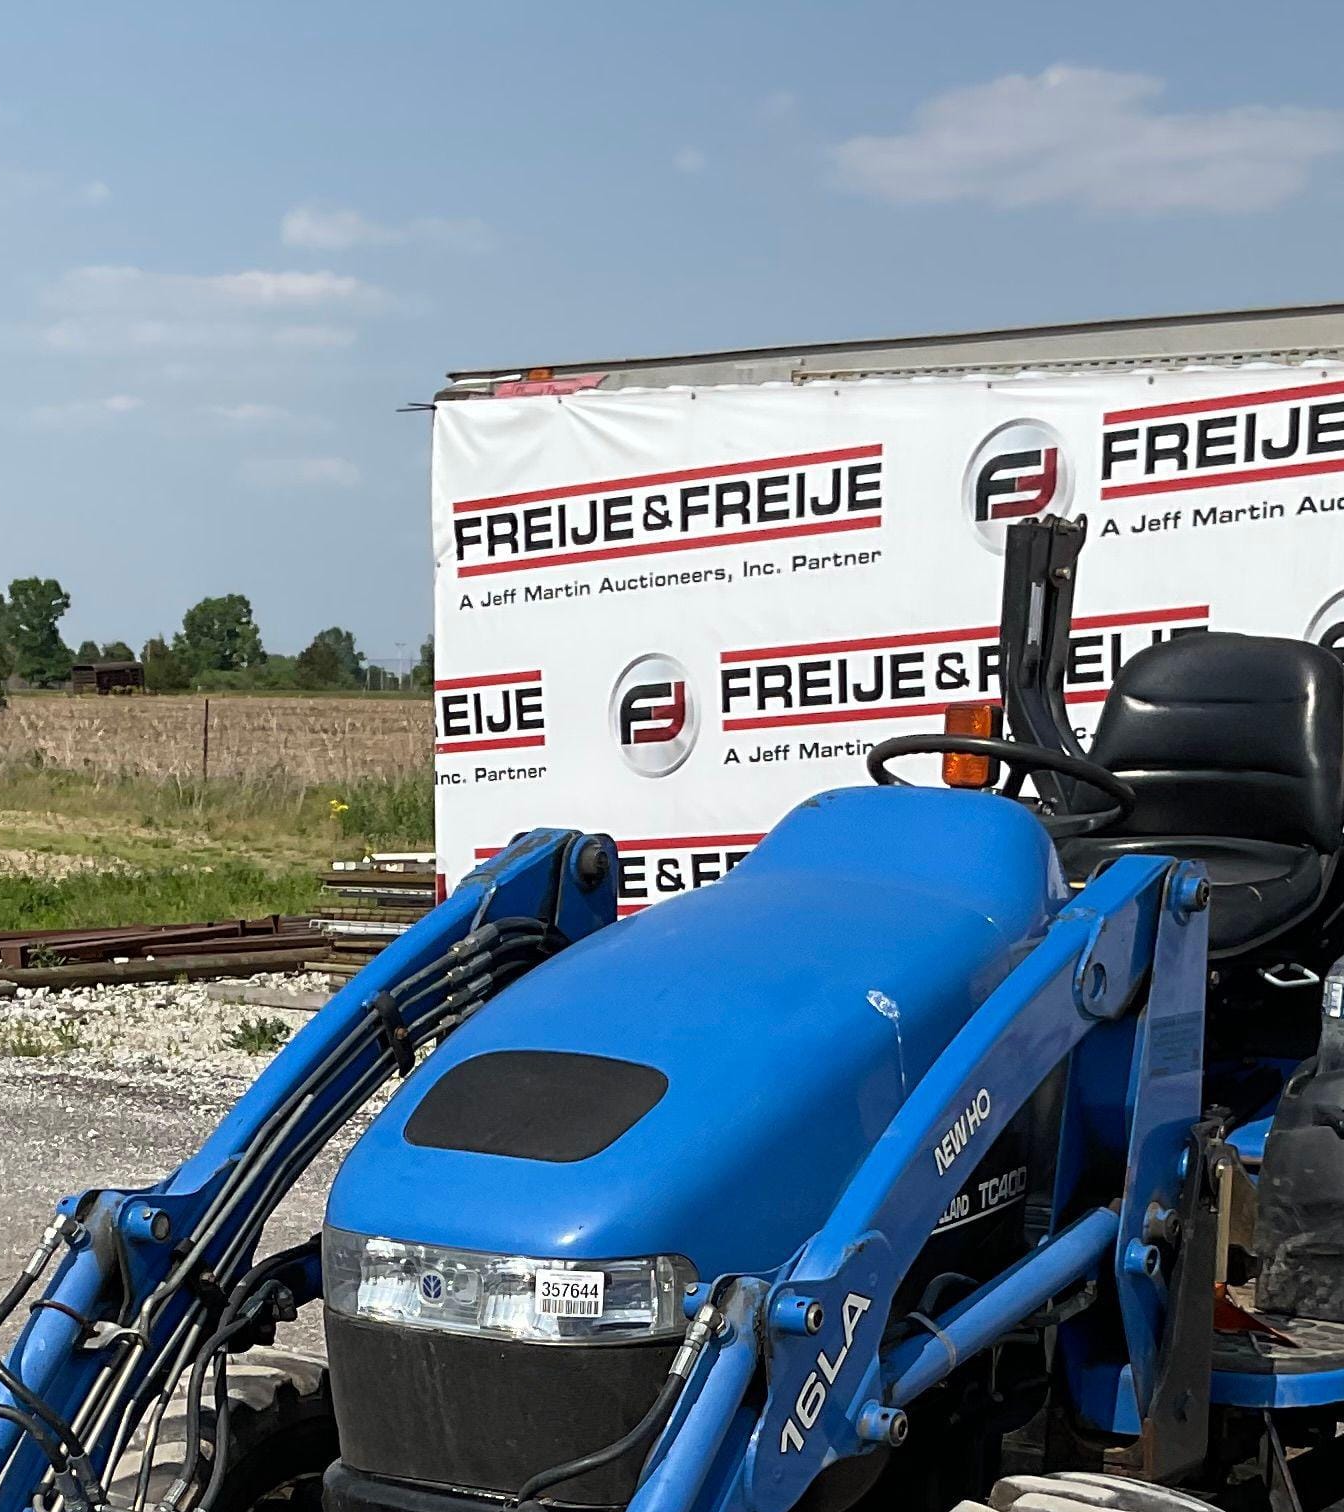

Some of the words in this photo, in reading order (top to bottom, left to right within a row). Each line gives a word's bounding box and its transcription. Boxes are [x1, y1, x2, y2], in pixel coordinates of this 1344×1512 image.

[454, 495, 634, 561] FREIJE
[642, 494, 673, 532] &
[680, 462, 883, 532] FREIJE
[1099, 519, 1121, 537] A
[1131, 511, 1182, 534] Jeff
[1192, 501, 1285, 527] Martin
[459, 594, 474, 611] A
[480, 588, 517, 608] Jeff
[524, 580, 591, 603] Martin
[599, 567, 733, 594] Auctioneers,
[743, 561, 781, 577] Inc.
[792, 550, 882, 572] Partner
[721, 651, 926, 714] FREIJE
[935, 651, 971, 691] &
[723, 748, 741, 766] A
[749, 745, 790, 763] Jeff
[474, 766, 547, 783] Partner
[939, 1194, 970, 1224] LAND
[541, 1281, 599, 1299] 357644
[778, 1291, 873, 1456] 16LA
